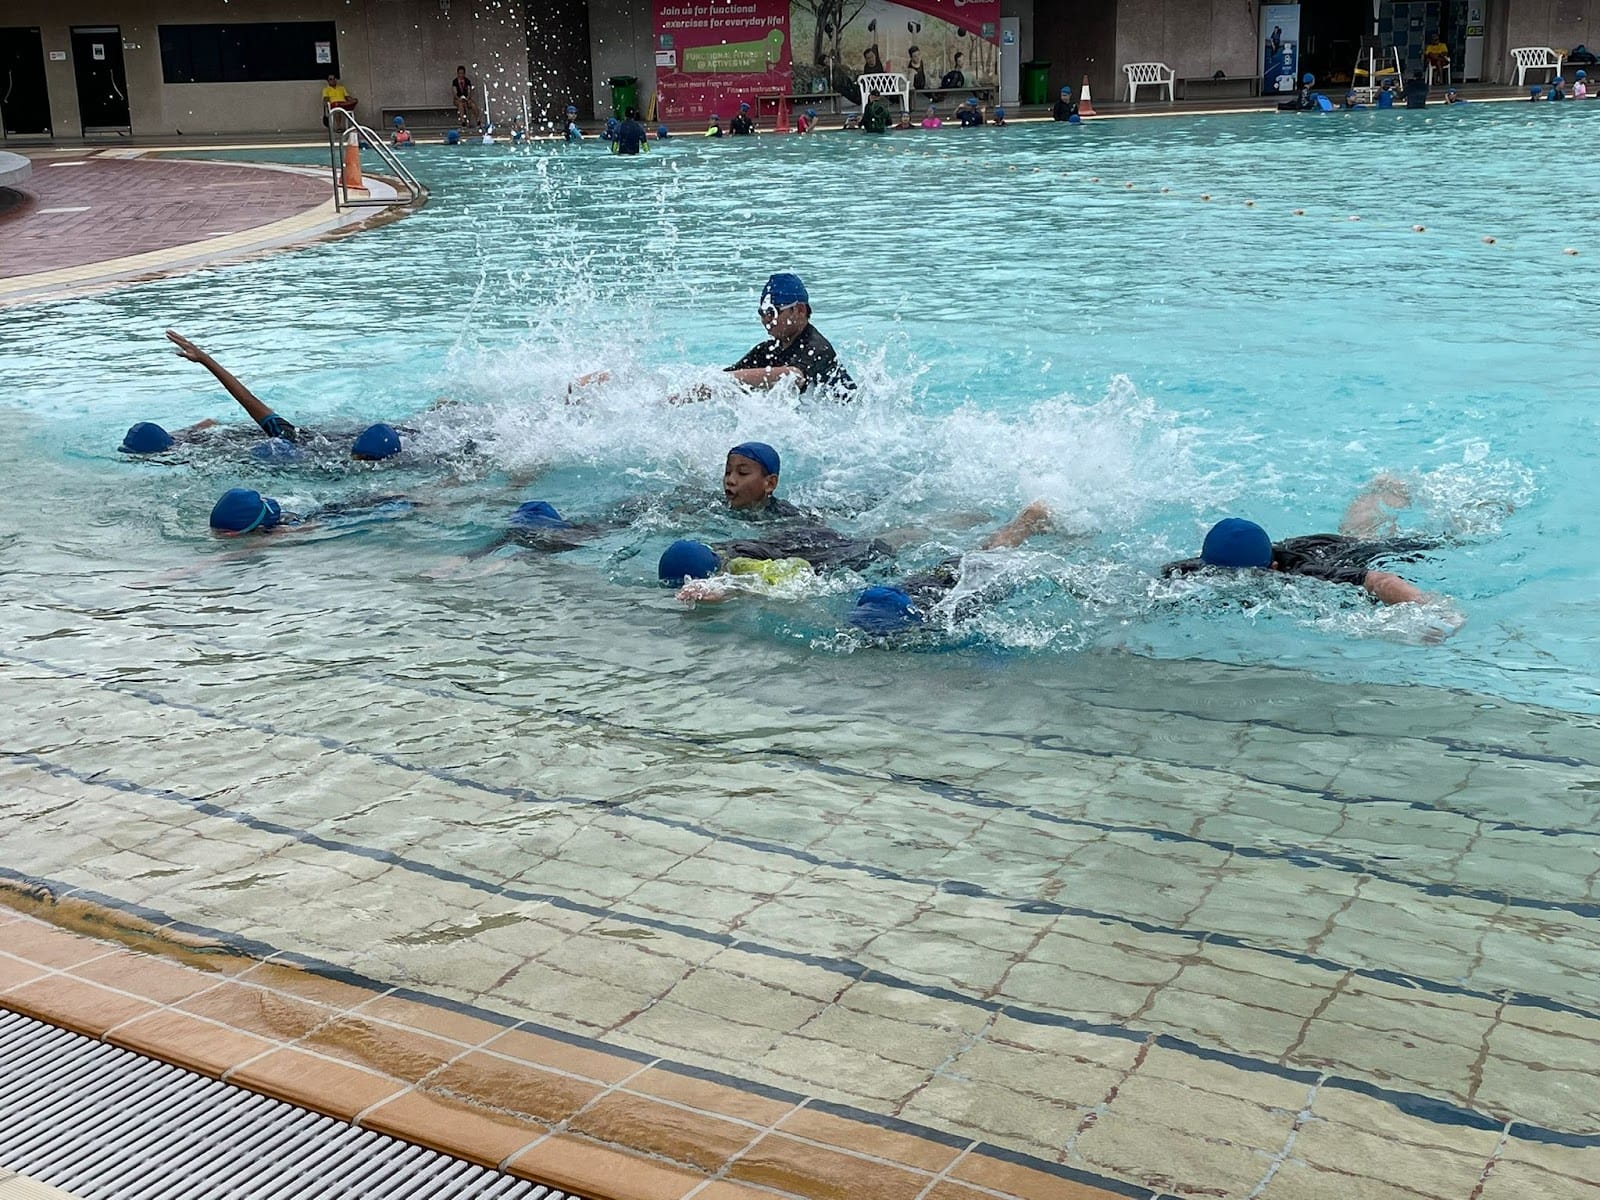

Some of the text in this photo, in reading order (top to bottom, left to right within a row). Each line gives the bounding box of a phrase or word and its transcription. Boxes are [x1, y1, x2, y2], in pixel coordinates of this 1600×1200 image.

[660, 3, 756, 16] Join us for functional
[665, 15, 784, 29] exercises for everyday life!
